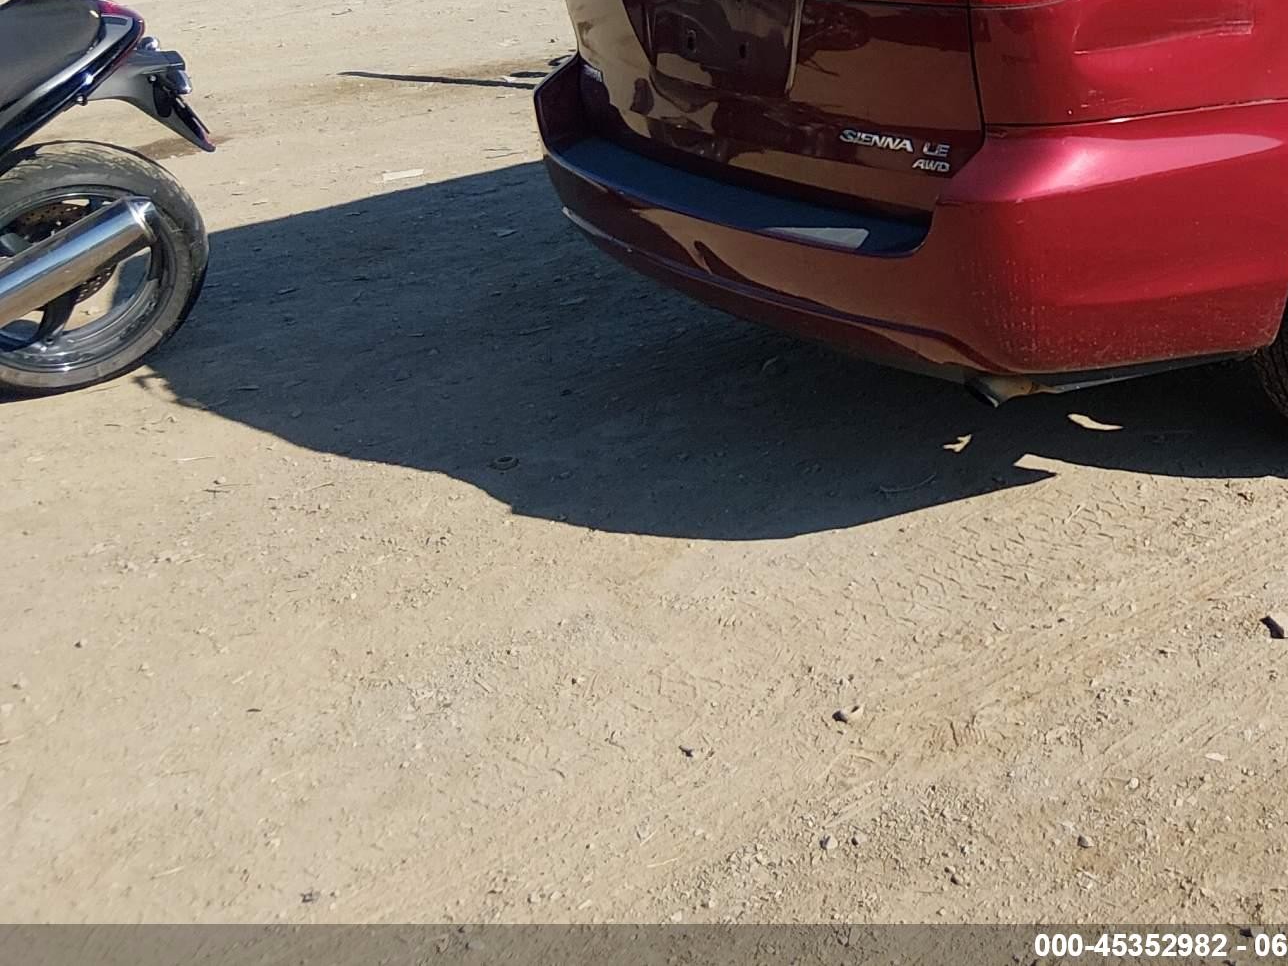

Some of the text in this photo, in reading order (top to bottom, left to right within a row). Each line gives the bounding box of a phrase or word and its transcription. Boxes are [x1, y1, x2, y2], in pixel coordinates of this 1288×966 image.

[839, 129, 950, 157] SIENNA LE
[911, 158, 950, 173] AWD
